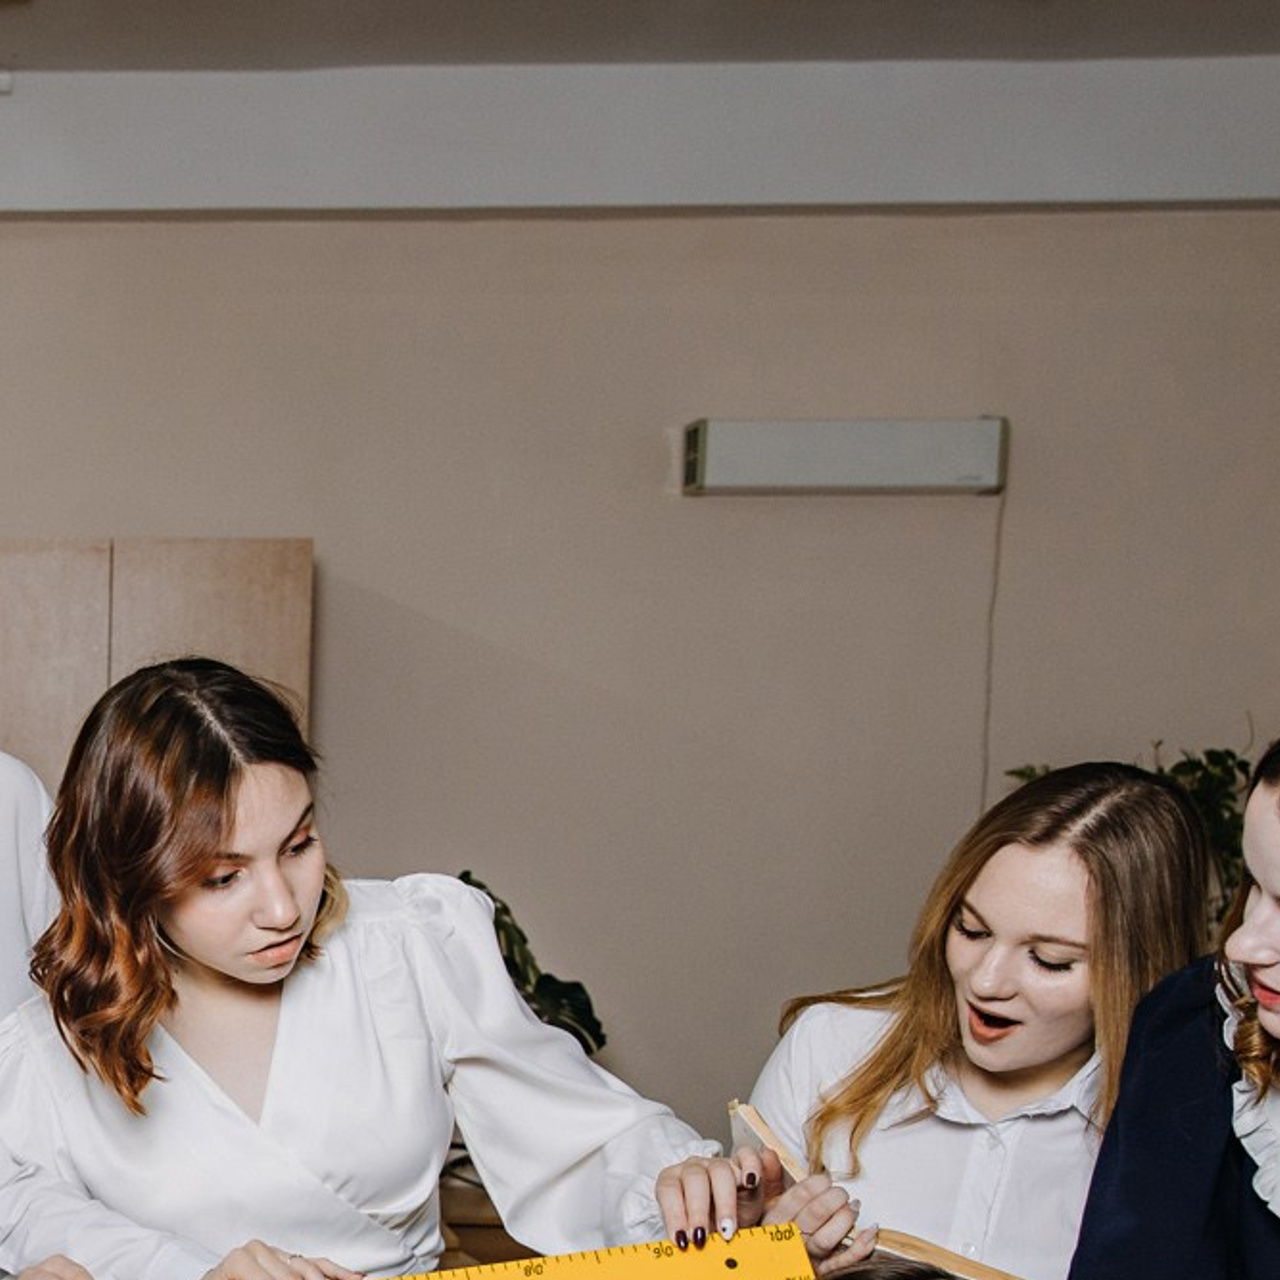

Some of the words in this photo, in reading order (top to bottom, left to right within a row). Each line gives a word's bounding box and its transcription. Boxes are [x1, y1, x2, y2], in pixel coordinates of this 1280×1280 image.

[524, 1263, 543, 1277] 80
[653, 1245, 673, 1258] 90
[769, 1228, 794, 1242] 100
